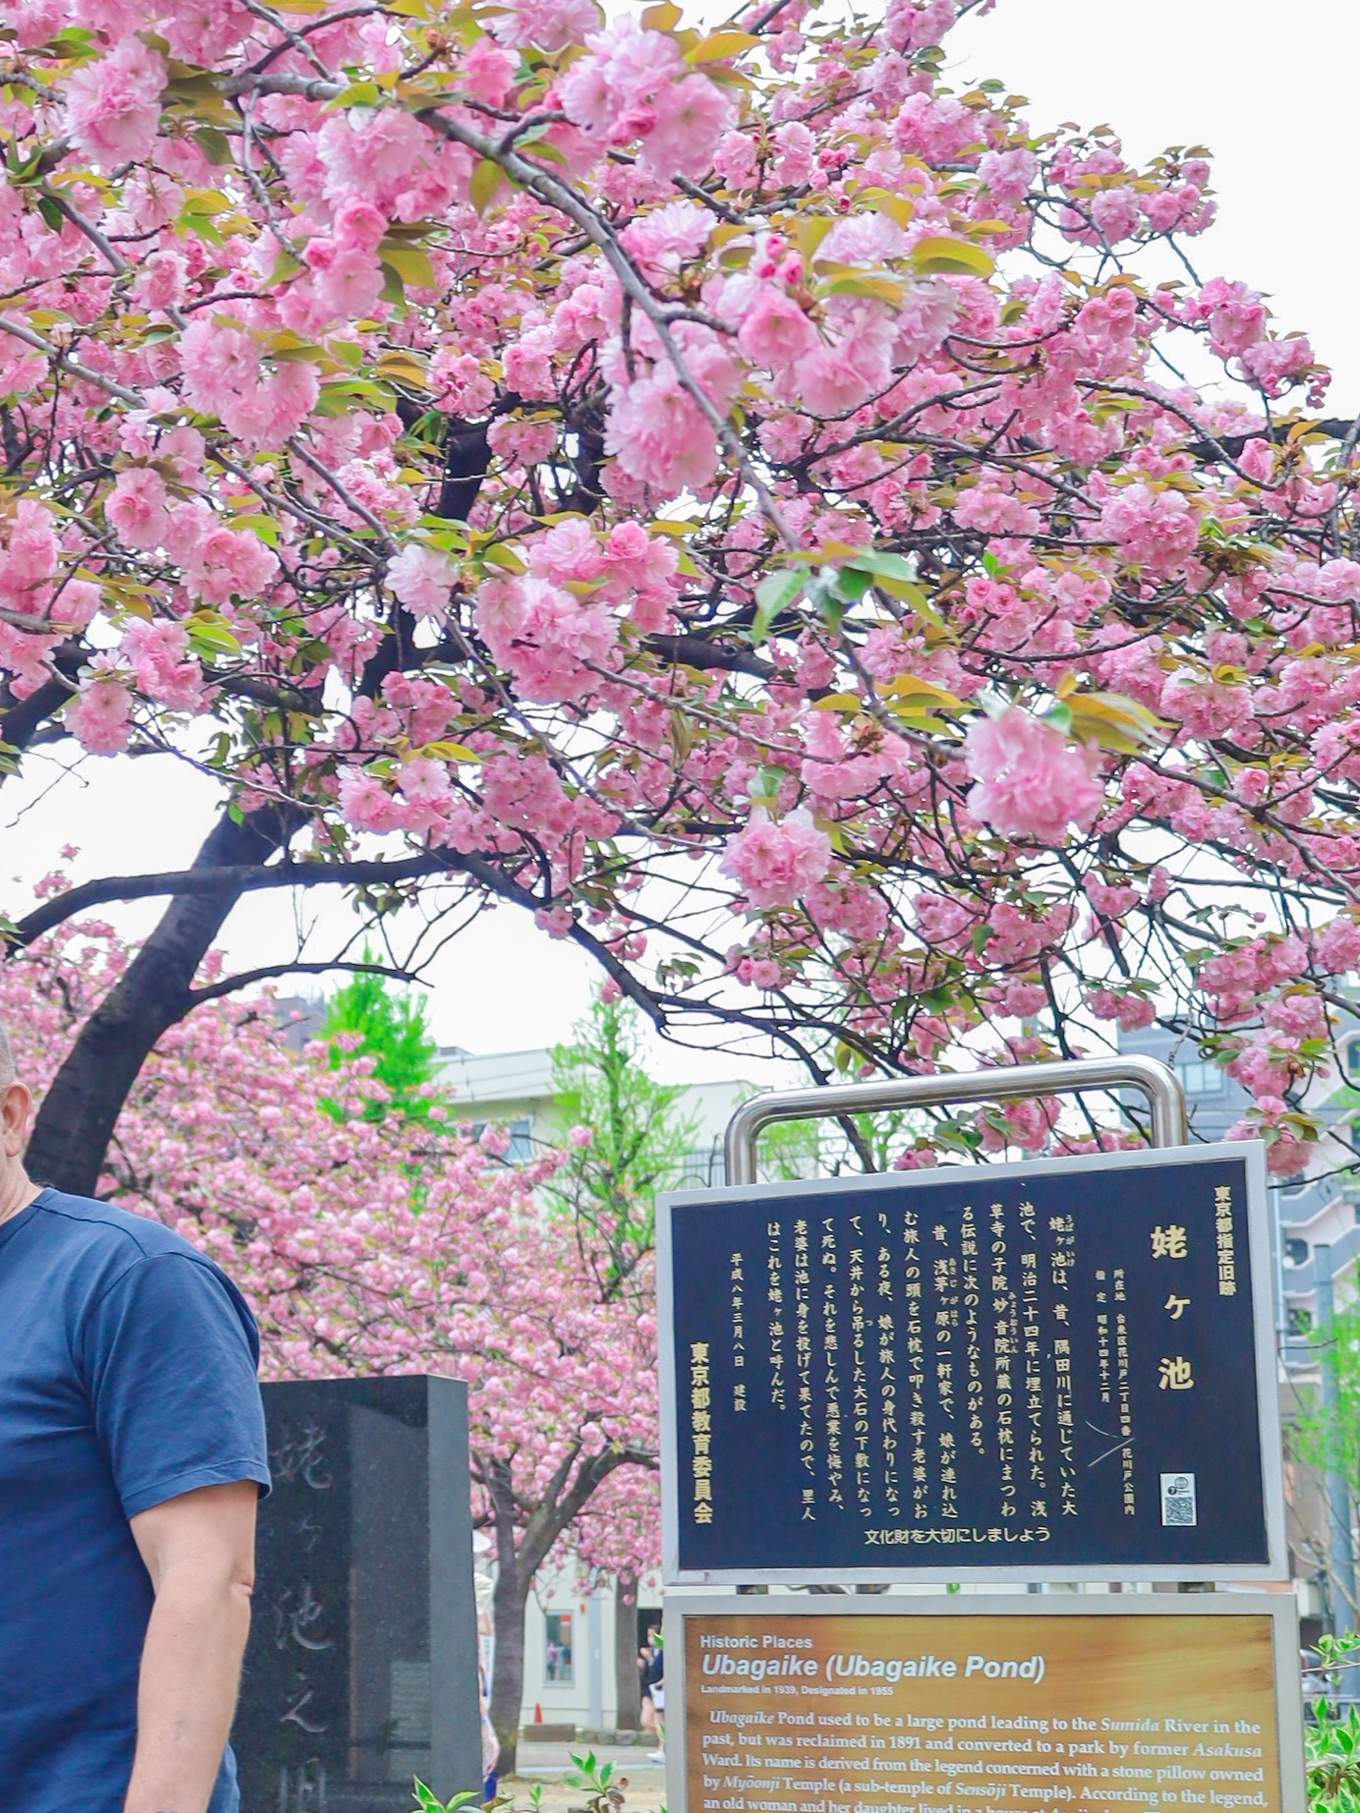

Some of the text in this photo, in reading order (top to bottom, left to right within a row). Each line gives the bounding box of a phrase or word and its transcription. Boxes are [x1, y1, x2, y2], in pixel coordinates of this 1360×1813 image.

[1214, 1186, 1236, 1295] 東京都指定旧跡
[691, 1342, 713, 1523] 東京都教育委員会
[864, 1527, 1050, 1544] 文化財を大切にしましょう
[700, 1633, 813, 1648] Historic Places
[703, 1652, 1046, 1685] Ubagaike (Ubagaike Pond)
[710, 1710, 1262, 1734] Ubagaike Pond used to be a large pond leading to the Sumida River in the
[703, 1732, 1262, 1758] past, but was reclaimed in 1891 and converted to a park by former Asakusa
[702, 1753, 1264, 1782] Ward. Its name is derived from the legend concerned with a stone pillow owned
[704, 1775, 721, 1791] by
[782, 1777, 836, 1794] Temple
[839, 1779, 852, 1794] (a
[854, 1779, 934, 1797] sub-temple
[937, 1782, 952, 1794] of
[1009, 1784, 1077, 1802] Temple).
[1079, 1786, 1160, 1806] According
[1162, 1791, 1177, 1803] to
[1181, 1789, 1206, 1804] the
[1210, 1790, 1268, 1808] legend,
